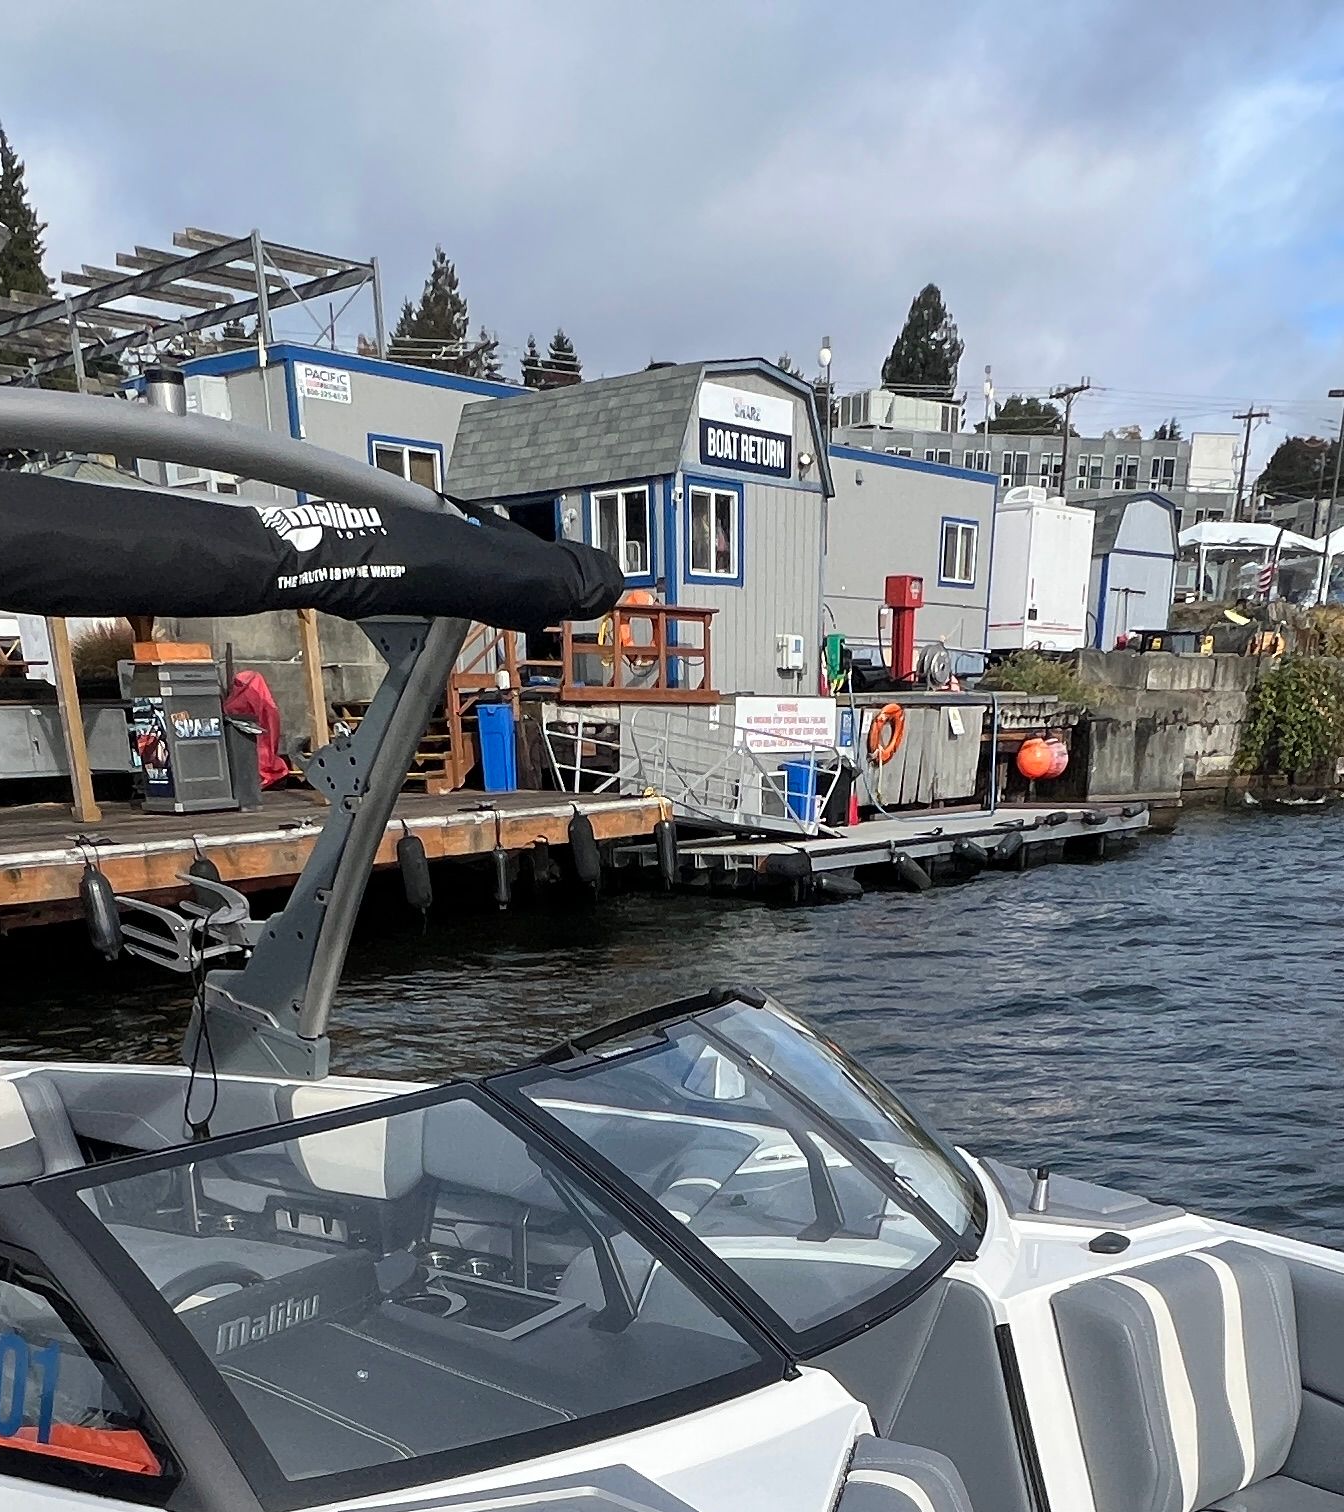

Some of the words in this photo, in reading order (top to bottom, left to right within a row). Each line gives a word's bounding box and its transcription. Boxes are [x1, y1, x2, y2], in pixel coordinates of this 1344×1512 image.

[305, 367, 347, 385] PACIFIC
[707, 427, 739, 460] BOAT
[740, 433, 785, 469] RETURN
[277, 575, 299, 590] THE
